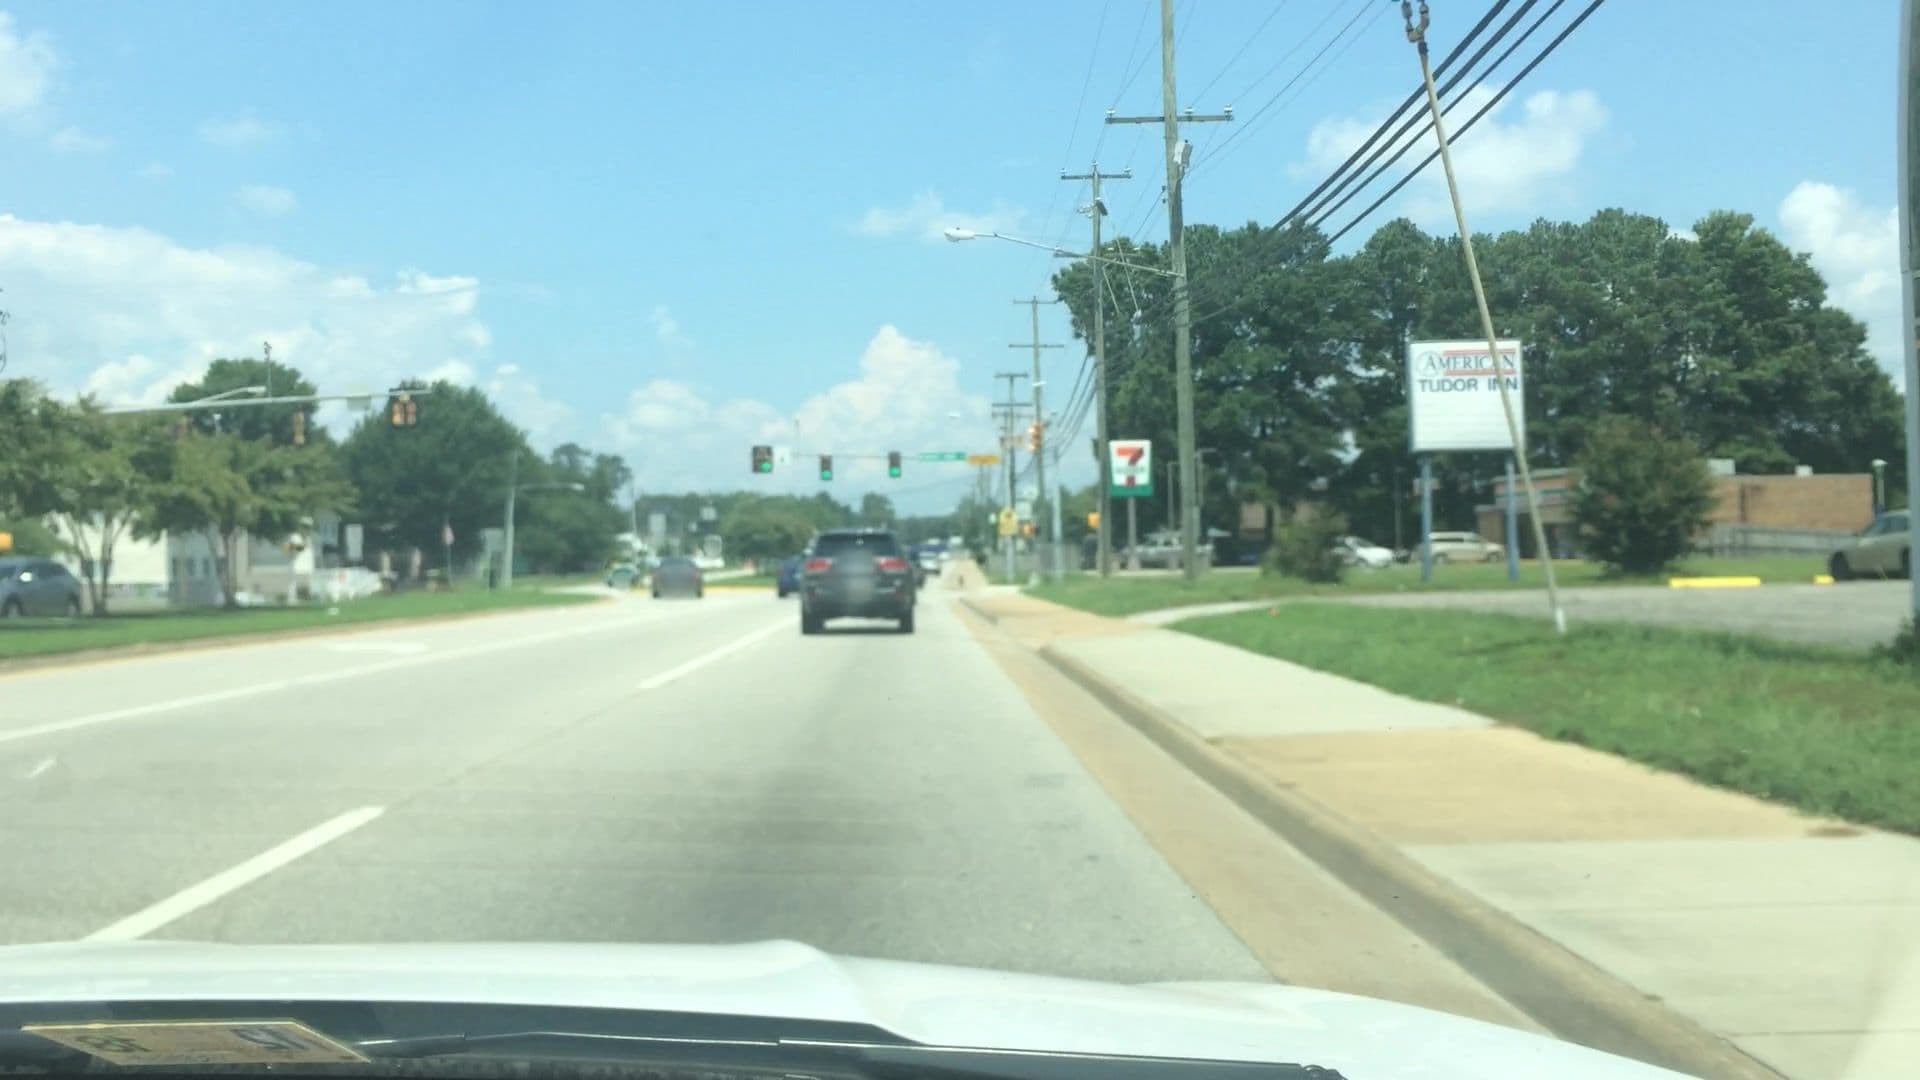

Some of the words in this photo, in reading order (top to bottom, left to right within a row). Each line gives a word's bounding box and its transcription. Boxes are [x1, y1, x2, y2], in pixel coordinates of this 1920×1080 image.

[1424, 354, 1515, 369] AMERICN
[1418, 378, 1478, 392] TUDOR
[1116, 447, 1144, 486] 7
